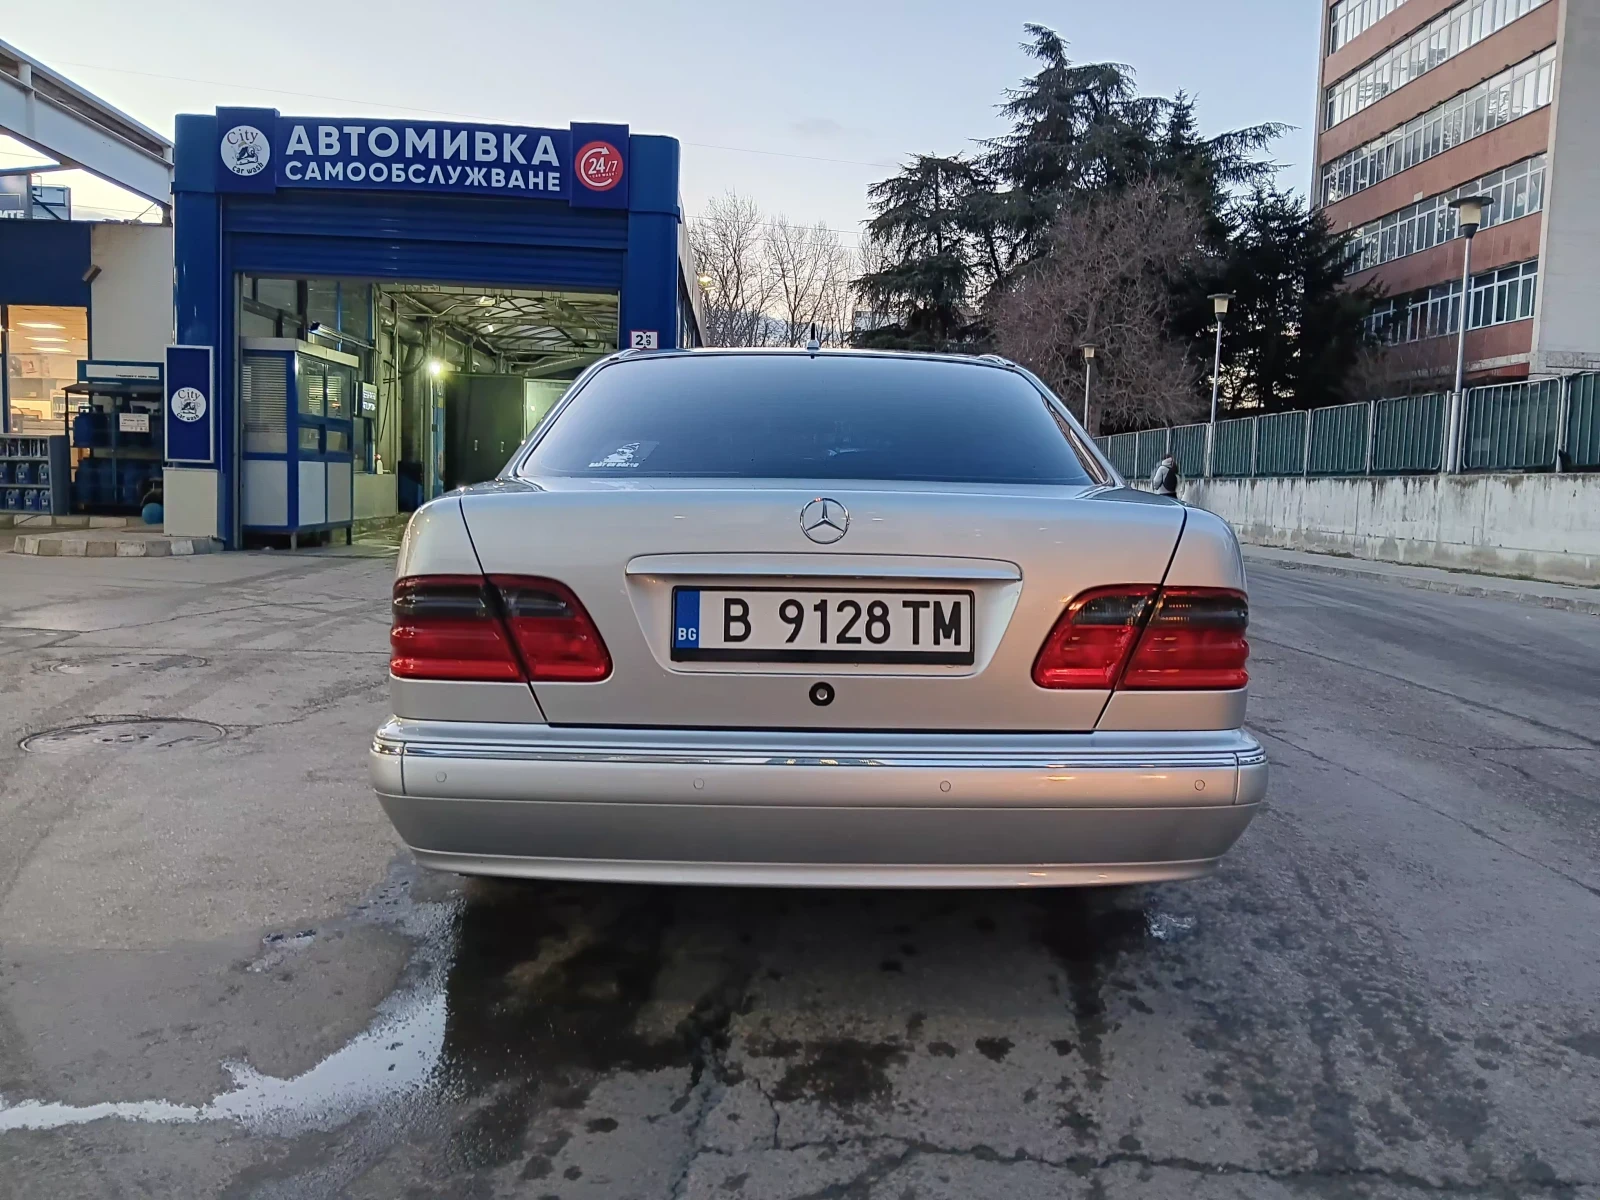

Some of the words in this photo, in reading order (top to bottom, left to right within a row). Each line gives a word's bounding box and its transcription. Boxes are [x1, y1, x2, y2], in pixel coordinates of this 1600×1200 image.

[227, 128, 258, 144] City
[285, 125, 560, 167] АВТОМИВКА
[232, 165, 244, 174] car
[246, 162, 264, 174] wash
[588, 157, 618, 174] 24/7
[285, 161, 560, 192] САМООБСЛУЖВАНЕ
[178, 389, 200, 401] City
[723, 597, 752, 643] B
[778, 598, 891, 645] 9128
[902, 600, 961, 646] TM
[678, 627, 697, 641] BG
